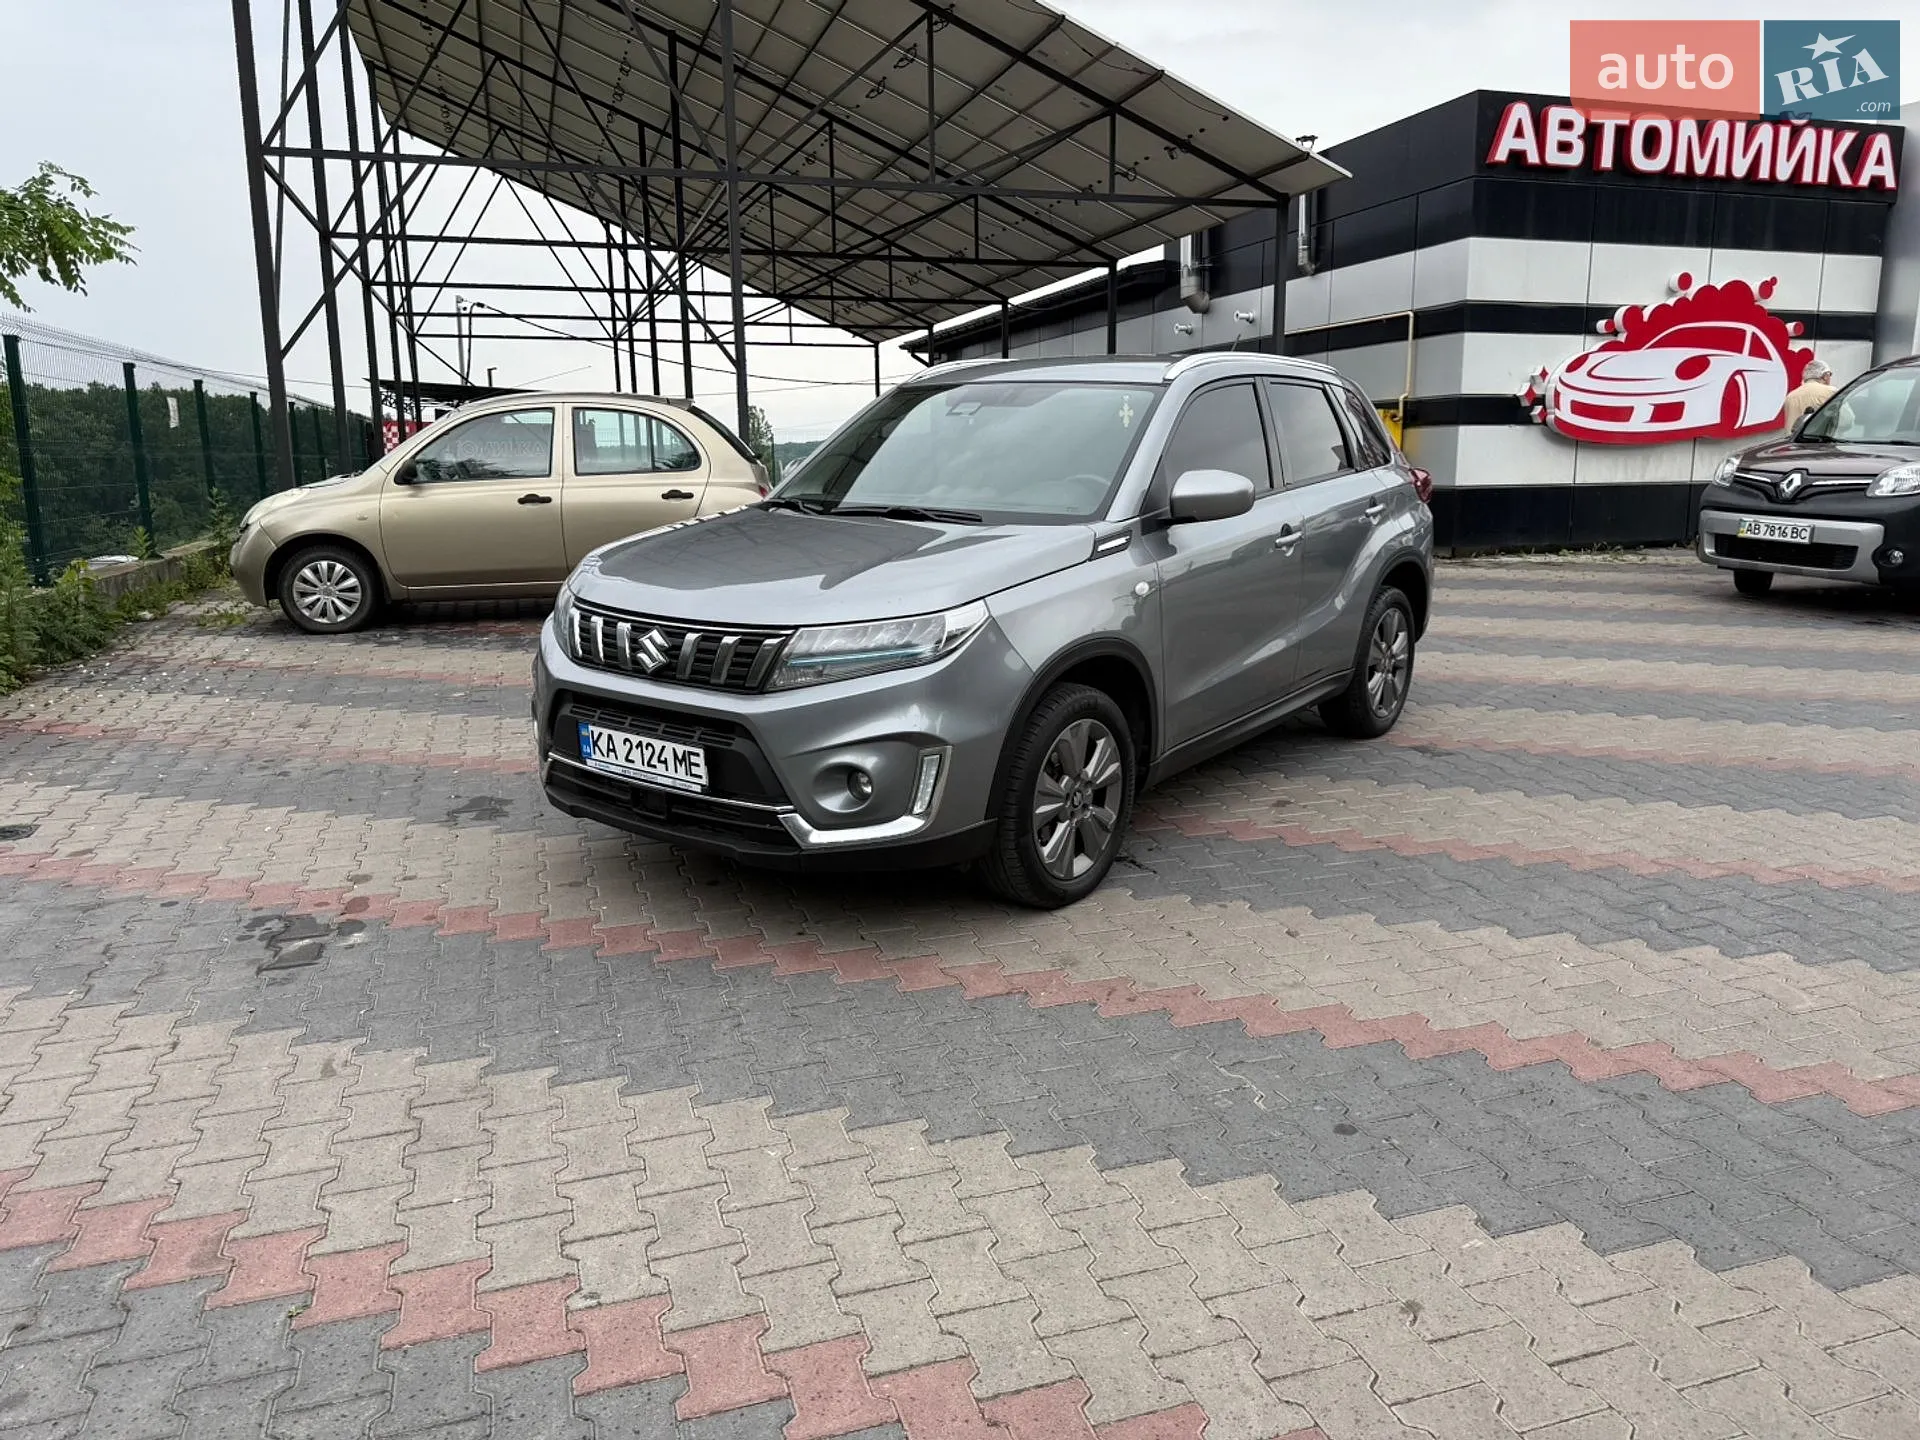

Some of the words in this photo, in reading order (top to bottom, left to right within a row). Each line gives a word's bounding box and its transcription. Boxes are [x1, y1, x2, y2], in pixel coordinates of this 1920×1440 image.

[1486, 101, 1898, 190] АВТОМИЙКА
[1745, 522, 1761, 536] AB
[1763, 524, 1788, 538] 7816
[1790, 526, 1808, 540] BC
[590, 729, 619, 761] KA
[622, 737, 669, 772] 2124
[672, 746, 704, 780] ME
